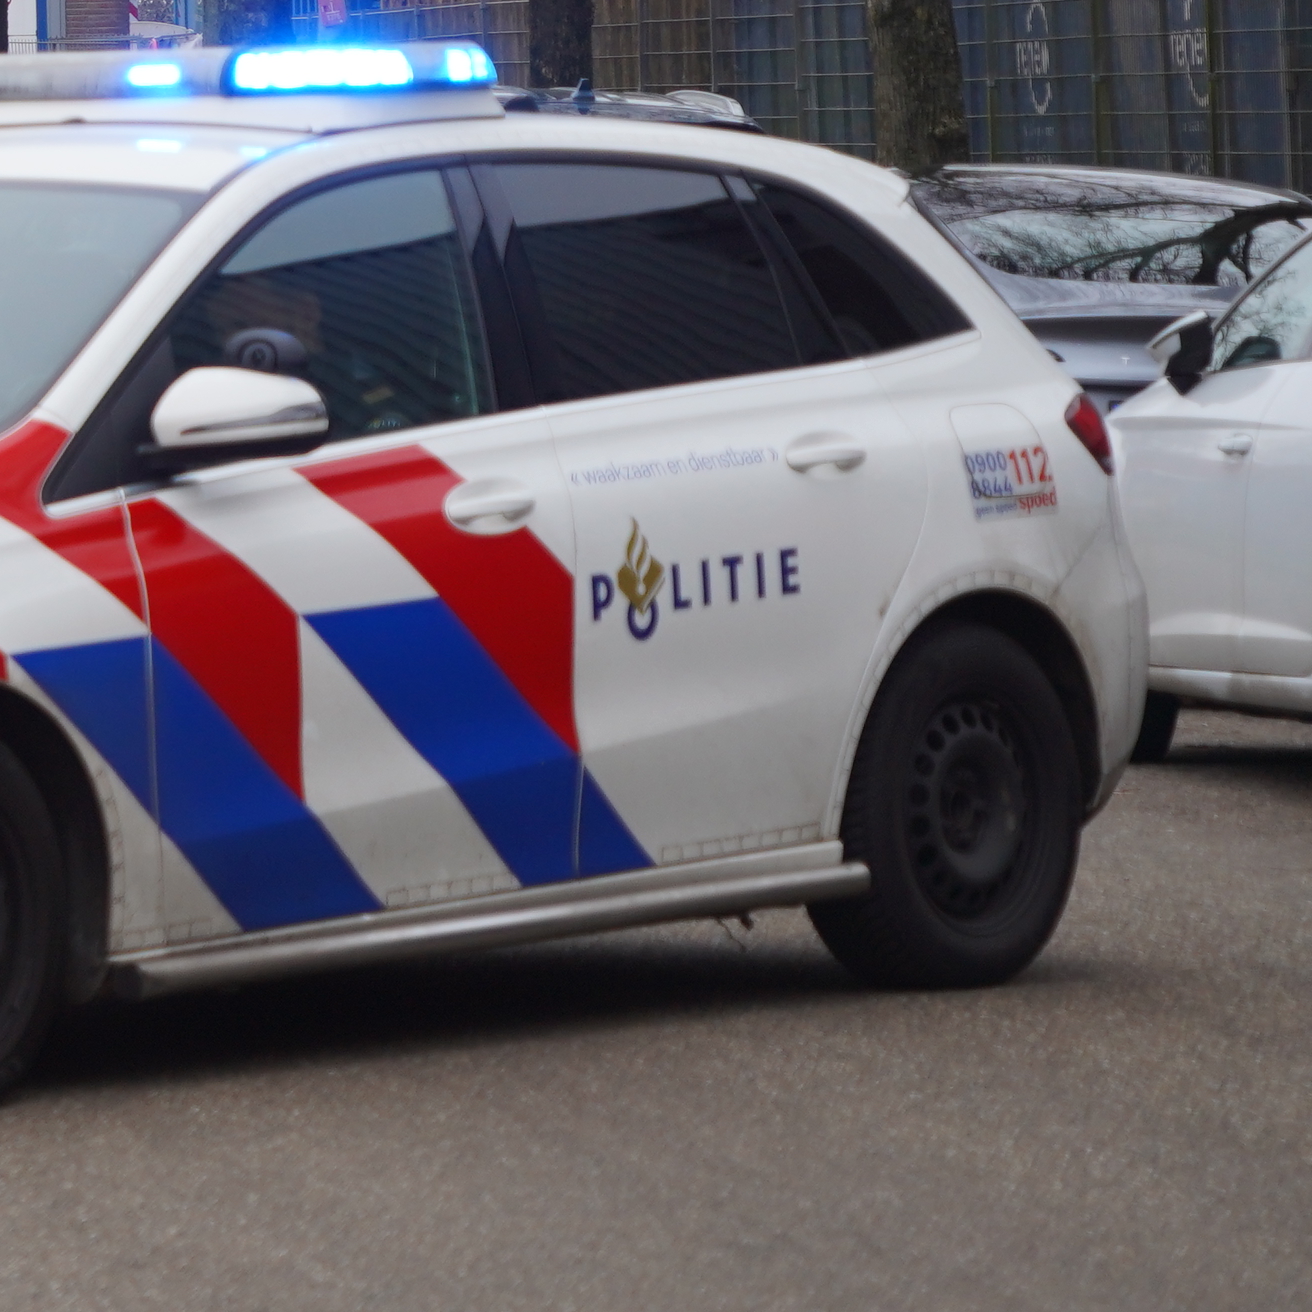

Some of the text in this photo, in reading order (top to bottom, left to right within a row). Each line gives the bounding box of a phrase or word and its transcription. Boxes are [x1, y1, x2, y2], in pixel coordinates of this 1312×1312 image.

[582, 461, 666, 485] waakzaam
[667, 459, 688, 474] en
[688, 446, 766, 473] dienstbaar
[965, 451, 1007, 474] 0900
[1018, 486, 1056, 514] spoed
[591, 547, 801, 641] POLITIE
